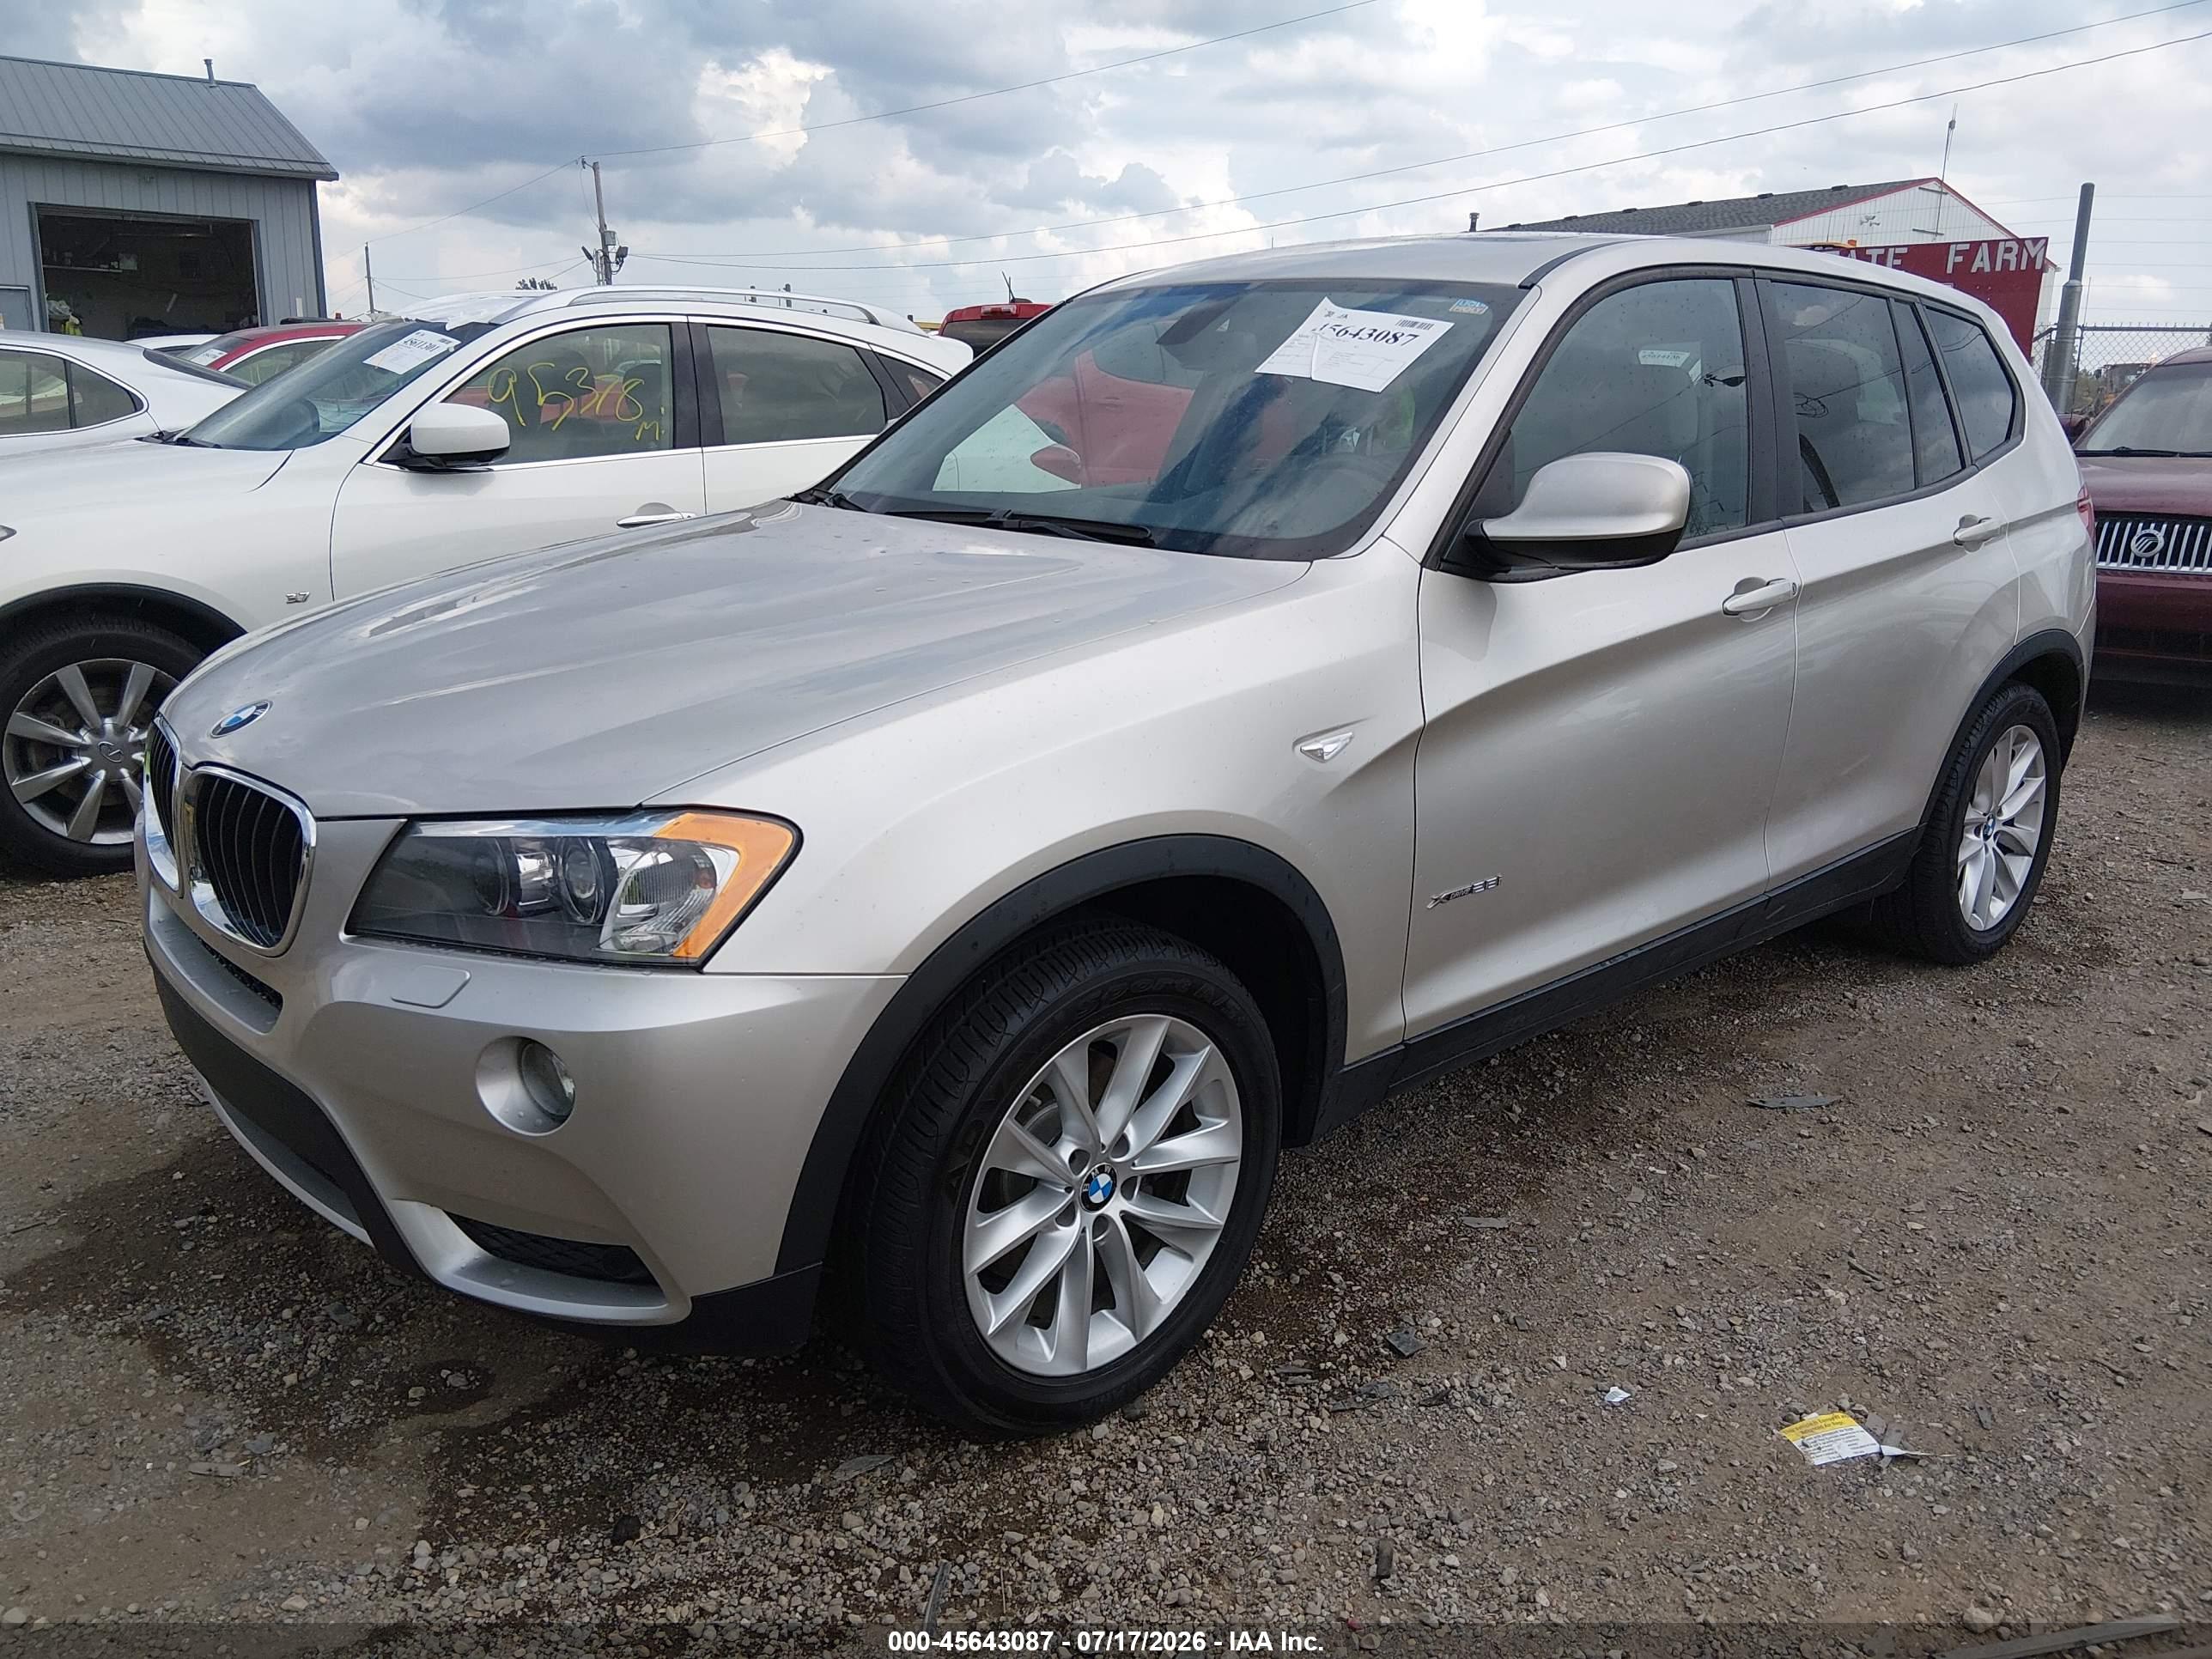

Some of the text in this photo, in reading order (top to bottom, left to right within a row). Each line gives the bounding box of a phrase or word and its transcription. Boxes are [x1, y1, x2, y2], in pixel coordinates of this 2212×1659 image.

[1947, 239, 2046, 274] FARM
[488, 362, 644, 430] 95378
[1082, 1164, 1112, 1192] BMW
